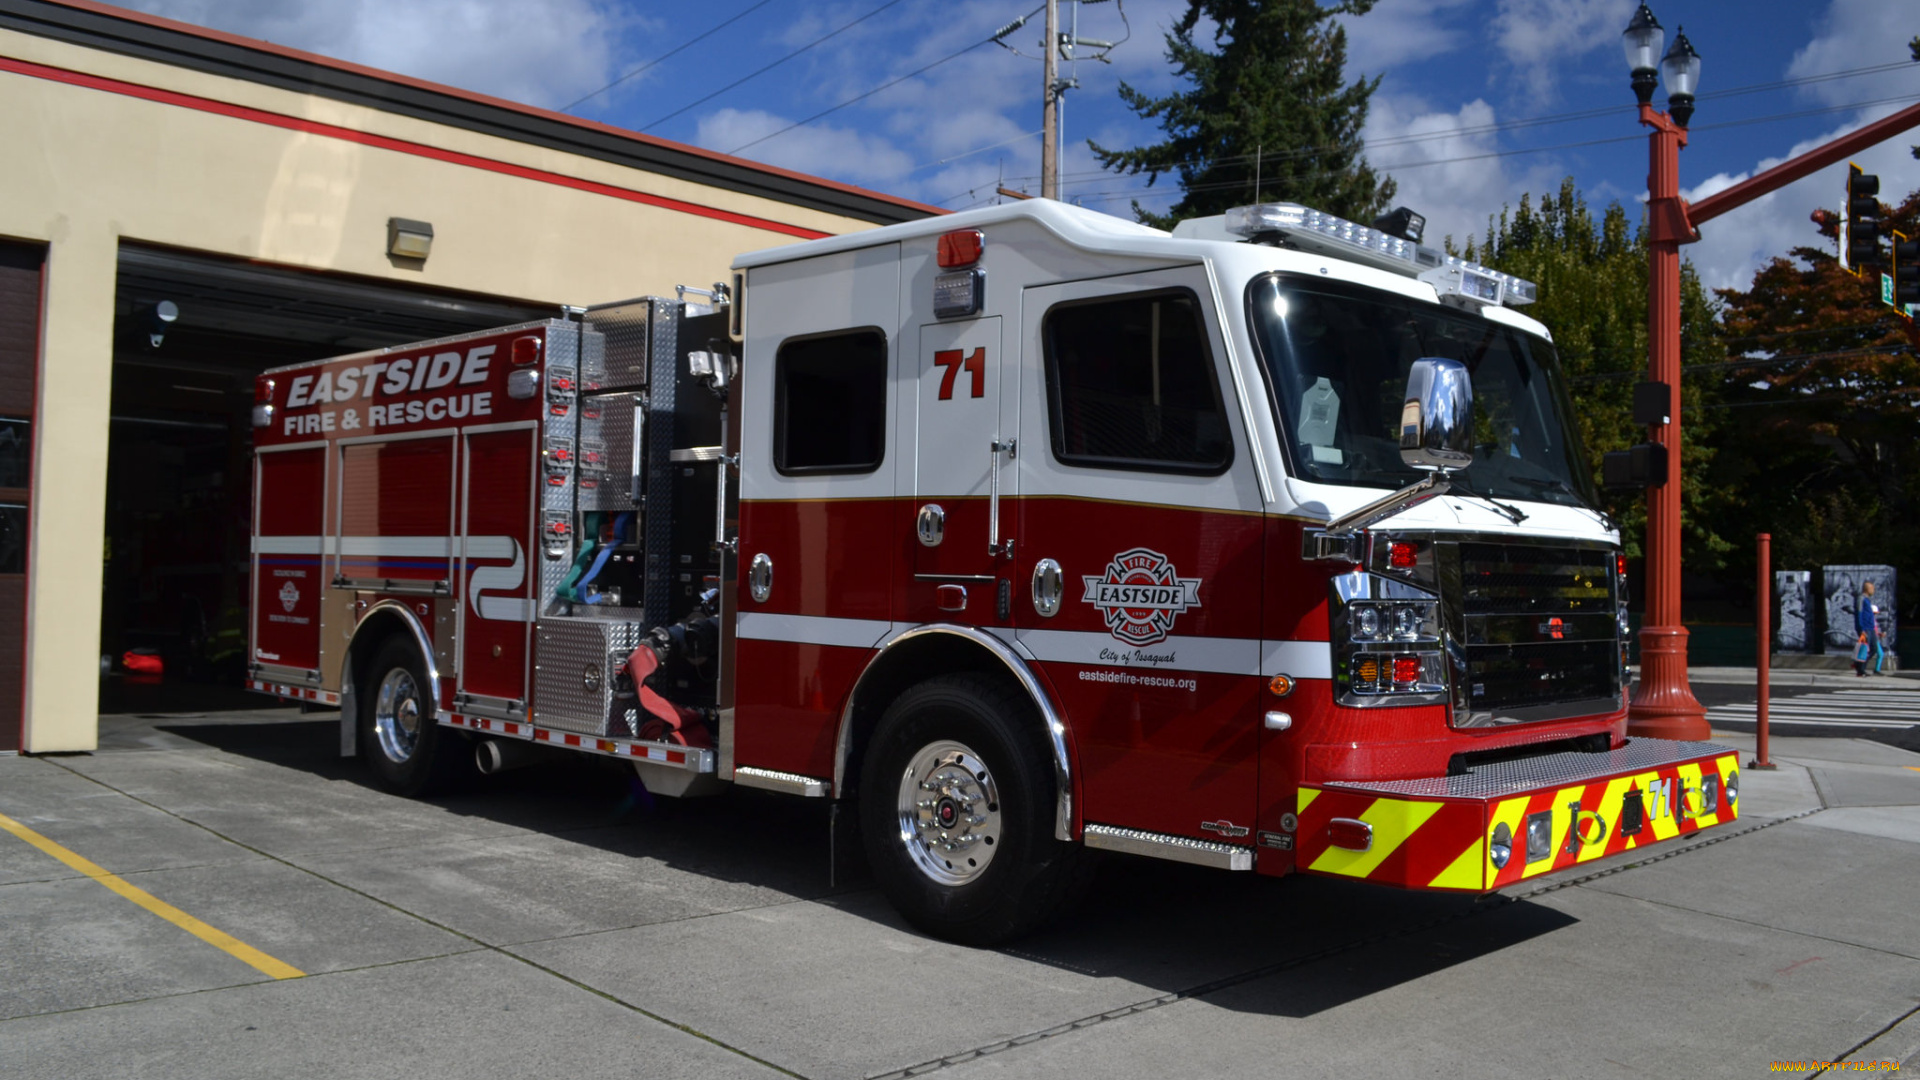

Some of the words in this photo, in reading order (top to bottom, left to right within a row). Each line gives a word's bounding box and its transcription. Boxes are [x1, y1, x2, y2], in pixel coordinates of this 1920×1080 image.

[286, 344, 497, 408] EASTSIDE
[934, 346, 986, 401] 71
[283, 411, 336, 436] FIRE
[341, 408, 360, 430] &
[368, 391, 492, 427] RESCUE
[1129, 557, 1152, 569] FIRE
[1100, 587, 1180, 605] EASTSIDE
[1127, 623, 1150, 634] RESCUE
[1099, 648, 1119, 663] City
[1121, 651, 1131, 665] of
[1134, 650, 1176, 666] Issaquah
[1078, 670, 1197, 692] eastsidefire-rescue.org
[1649, 777, 1672, 821] 71
